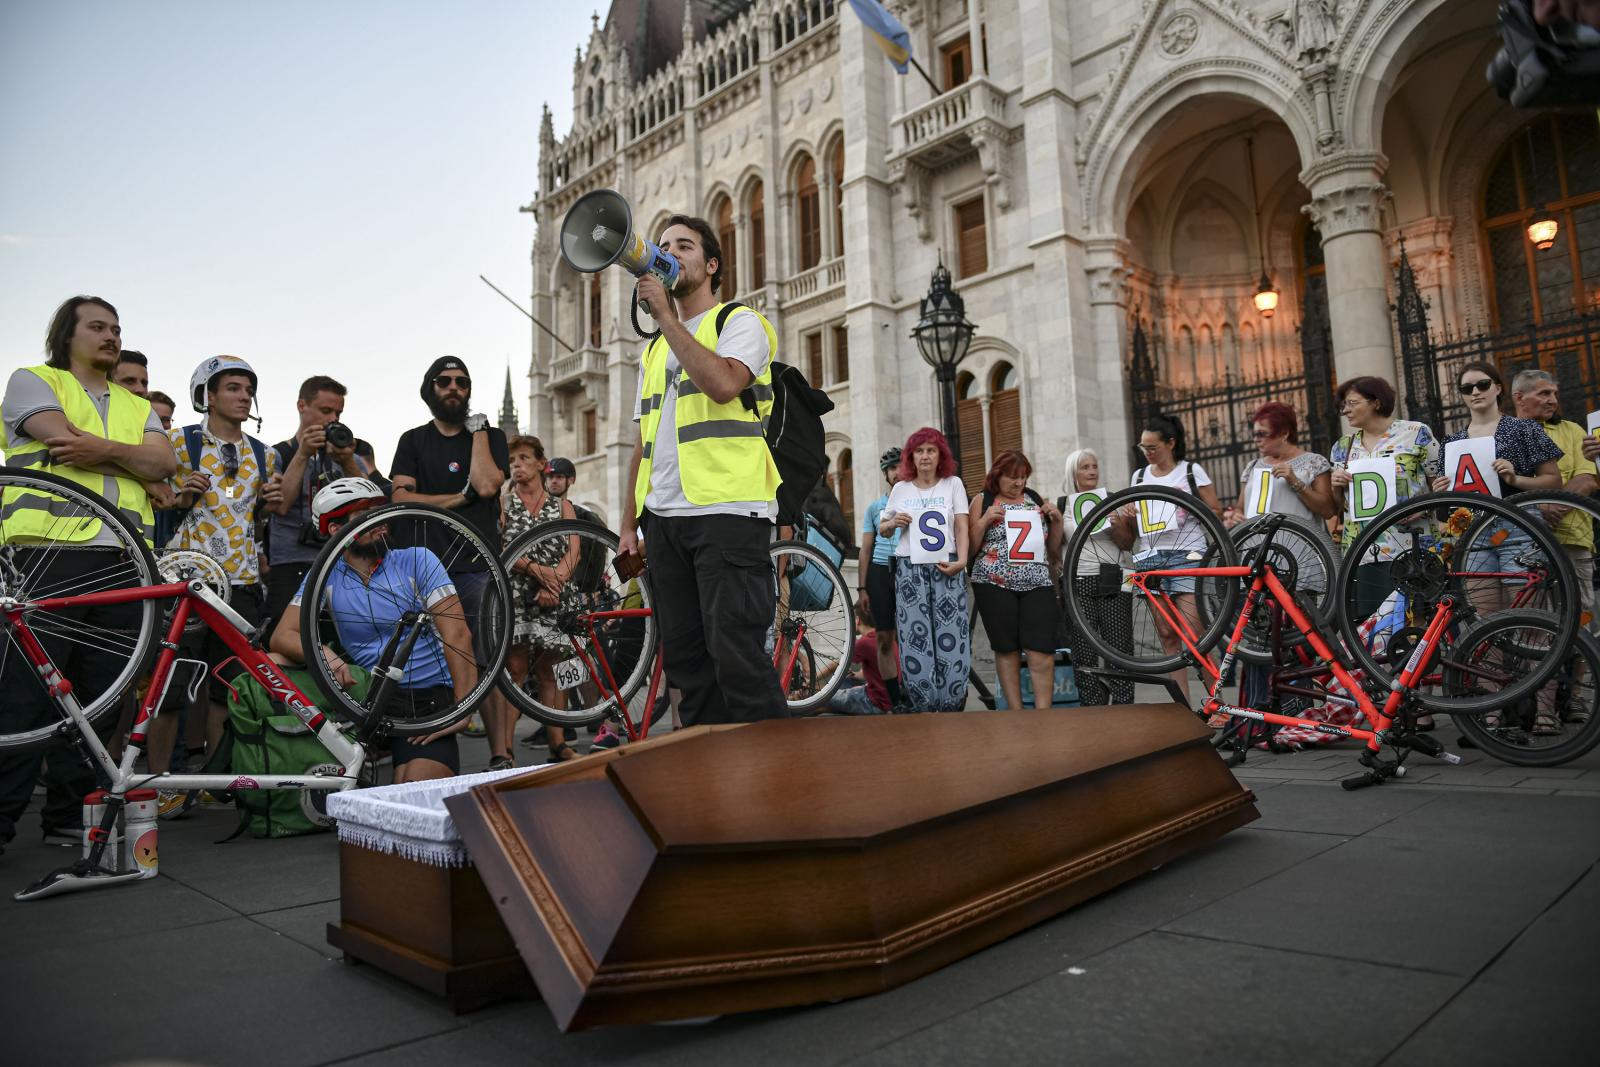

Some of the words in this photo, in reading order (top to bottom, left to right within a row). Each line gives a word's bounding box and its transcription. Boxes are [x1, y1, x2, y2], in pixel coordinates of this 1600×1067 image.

[1256, 471, 1270, 515] I
[1352, 471, 1388, 519] D
[1453, 453, 1493, 496] A
[904, 496, 945, 508] SUMMER
[1139, 500, 1167, 534] L
[919, 510, 946, 552] S
[1007, 521, 1035, 561] Z
